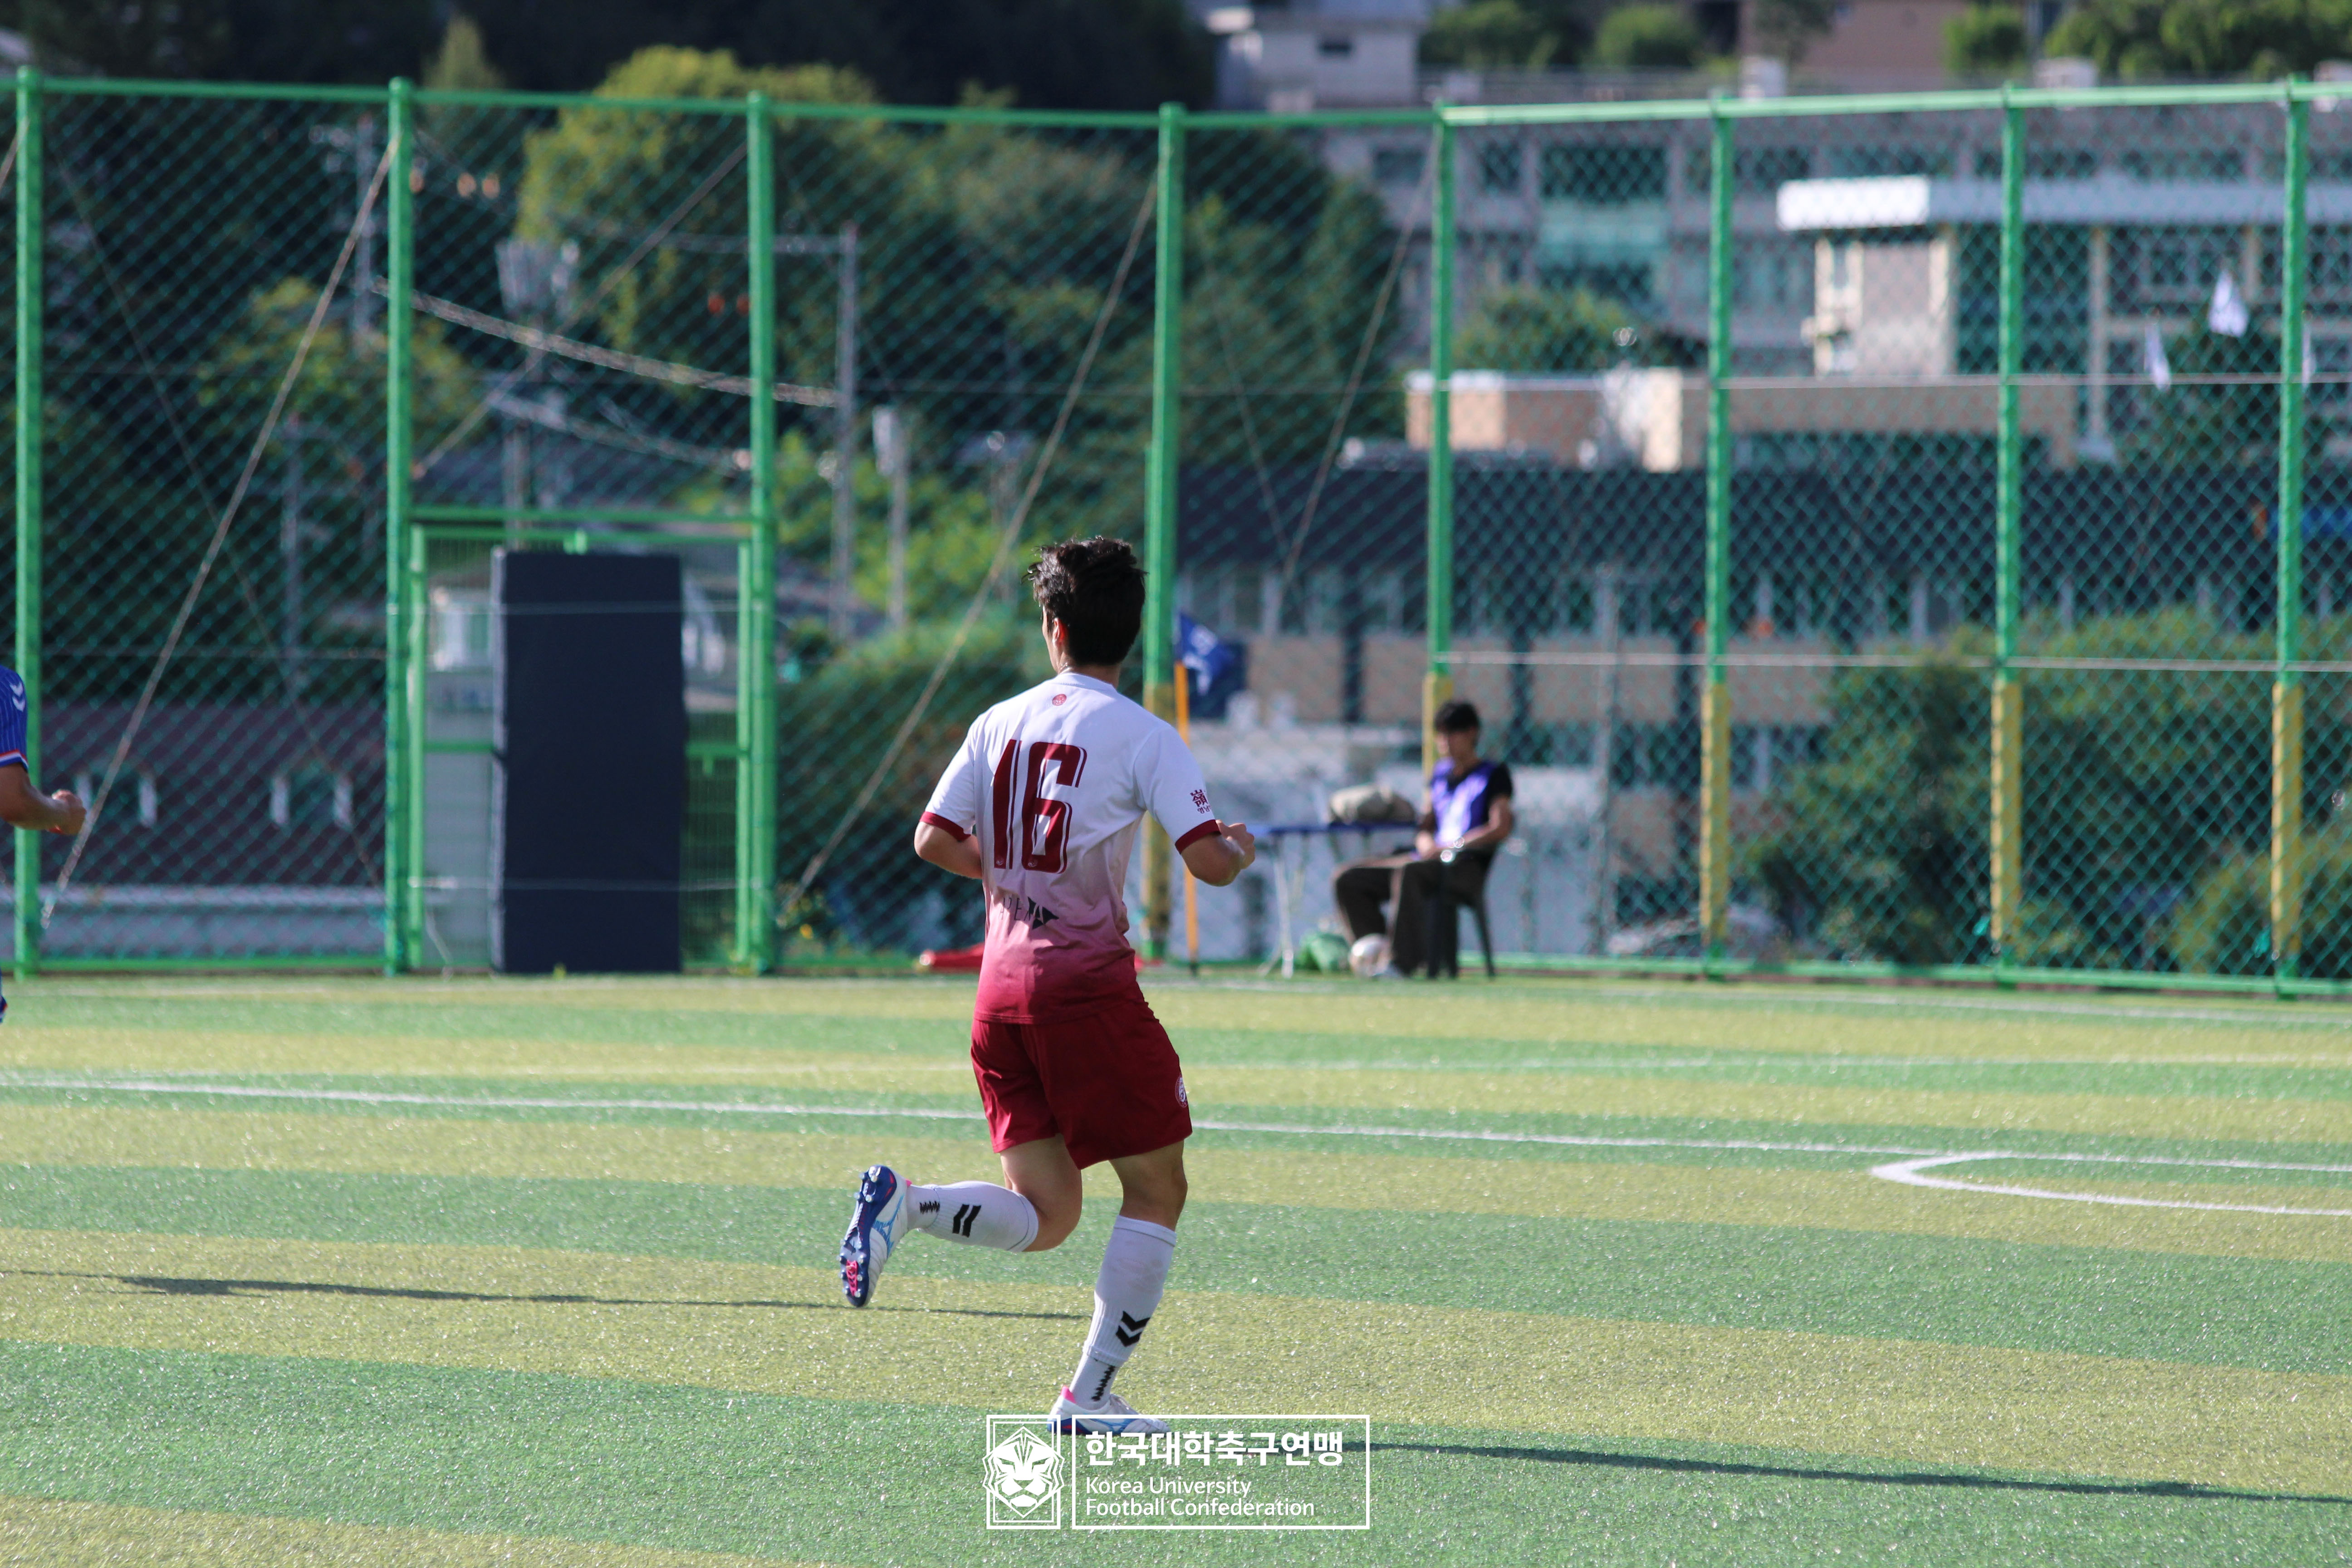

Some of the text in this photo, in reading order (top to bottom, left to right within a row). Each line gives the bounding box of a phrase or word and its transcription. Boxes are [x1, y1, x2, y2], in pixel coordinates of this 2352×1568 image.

[993, 739, 1087, 874] 16
[1190, 789, 1209, 807] 嶺
[1197, 805, 1211, 814] 영남
